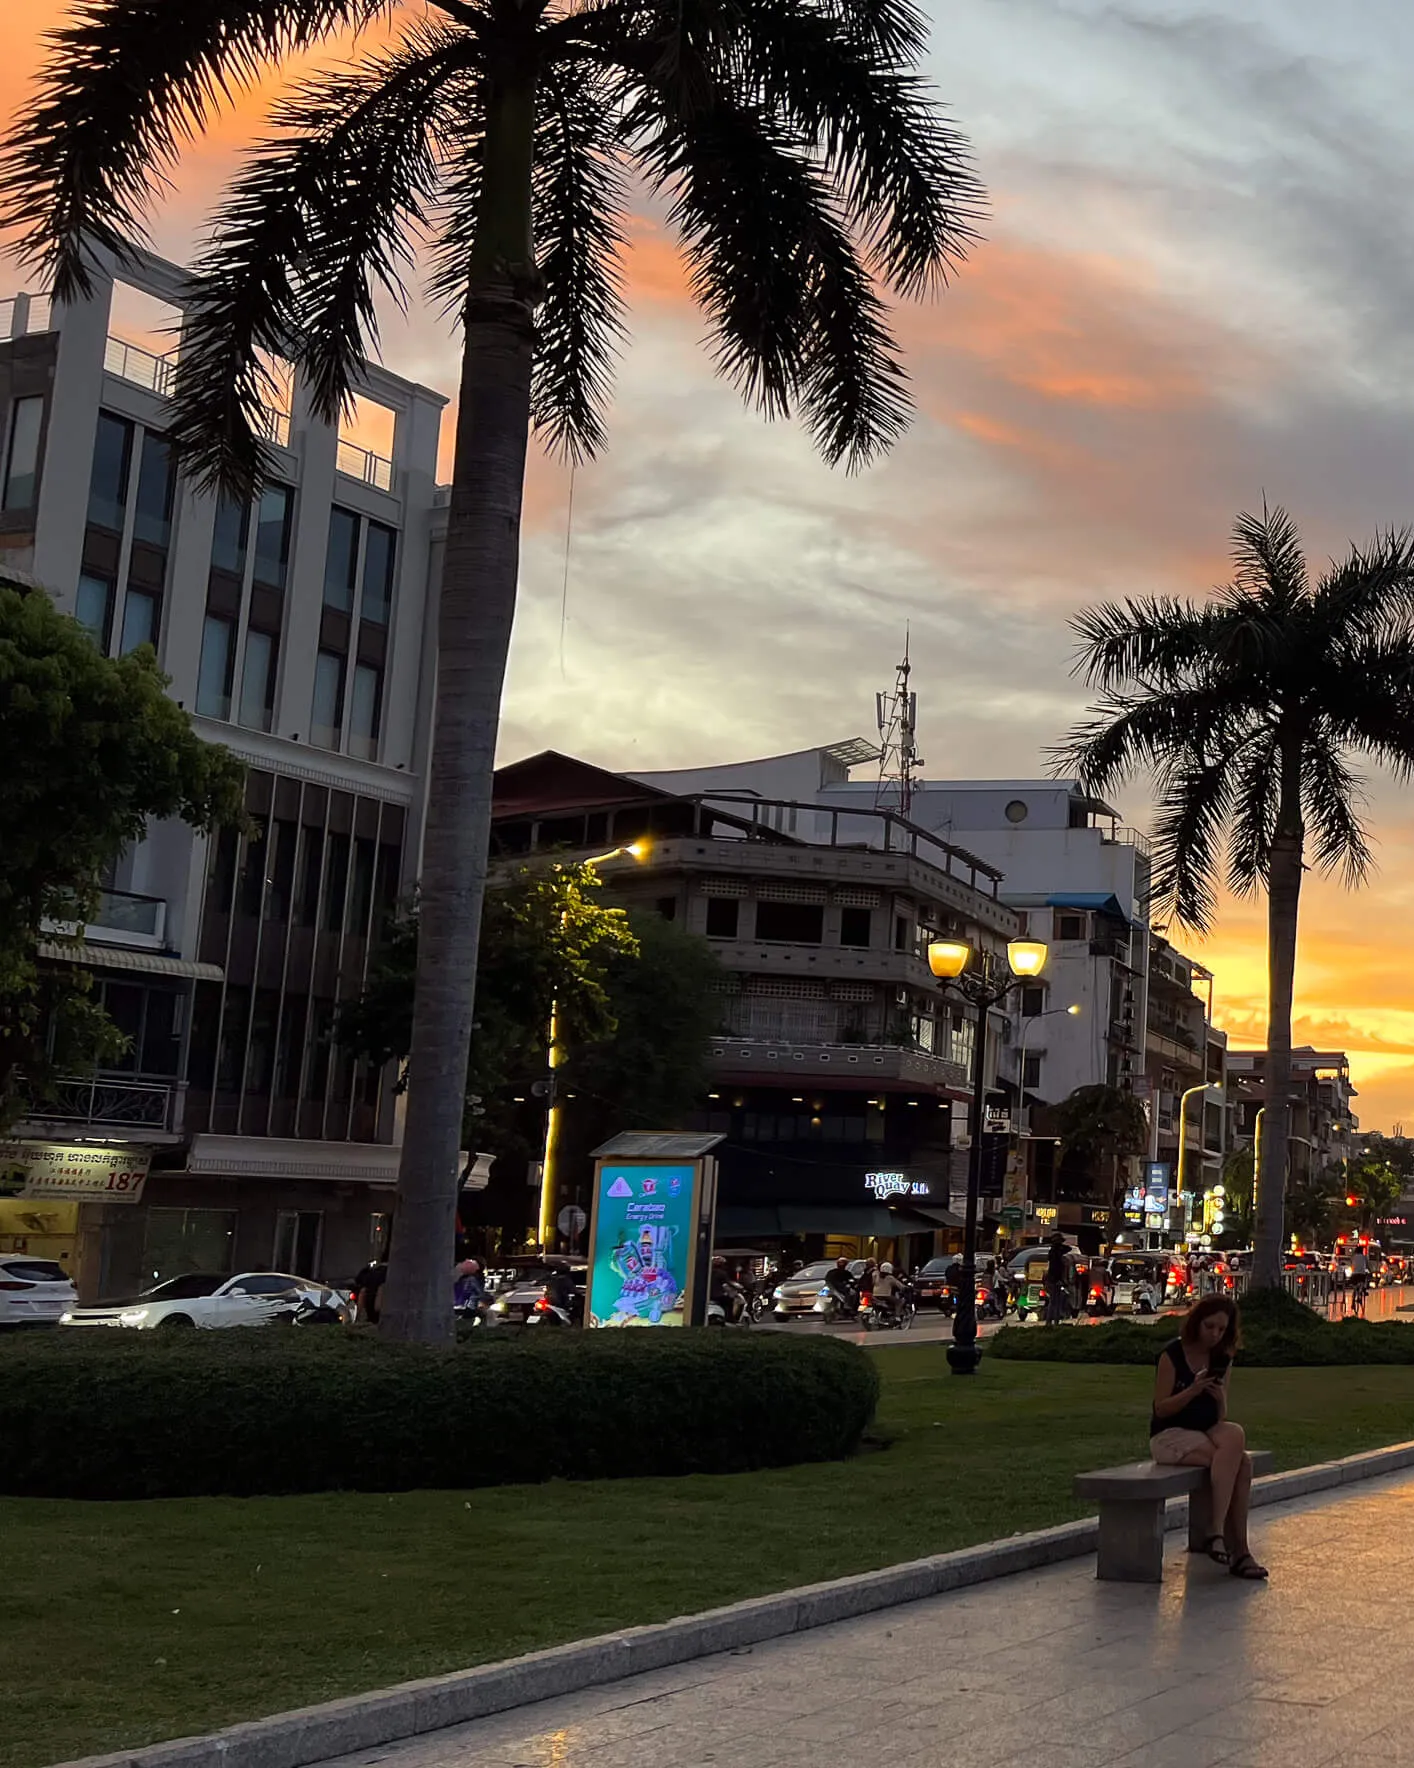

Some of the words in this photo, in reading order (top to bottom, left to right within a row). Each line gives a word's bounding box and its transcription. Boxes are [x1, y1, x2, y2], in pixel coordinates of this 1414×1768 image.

[105, 1172, 145, 1191] 187
[864, 1173, 904, 1188] River
[874, 1181, 911, 1199] Quay
